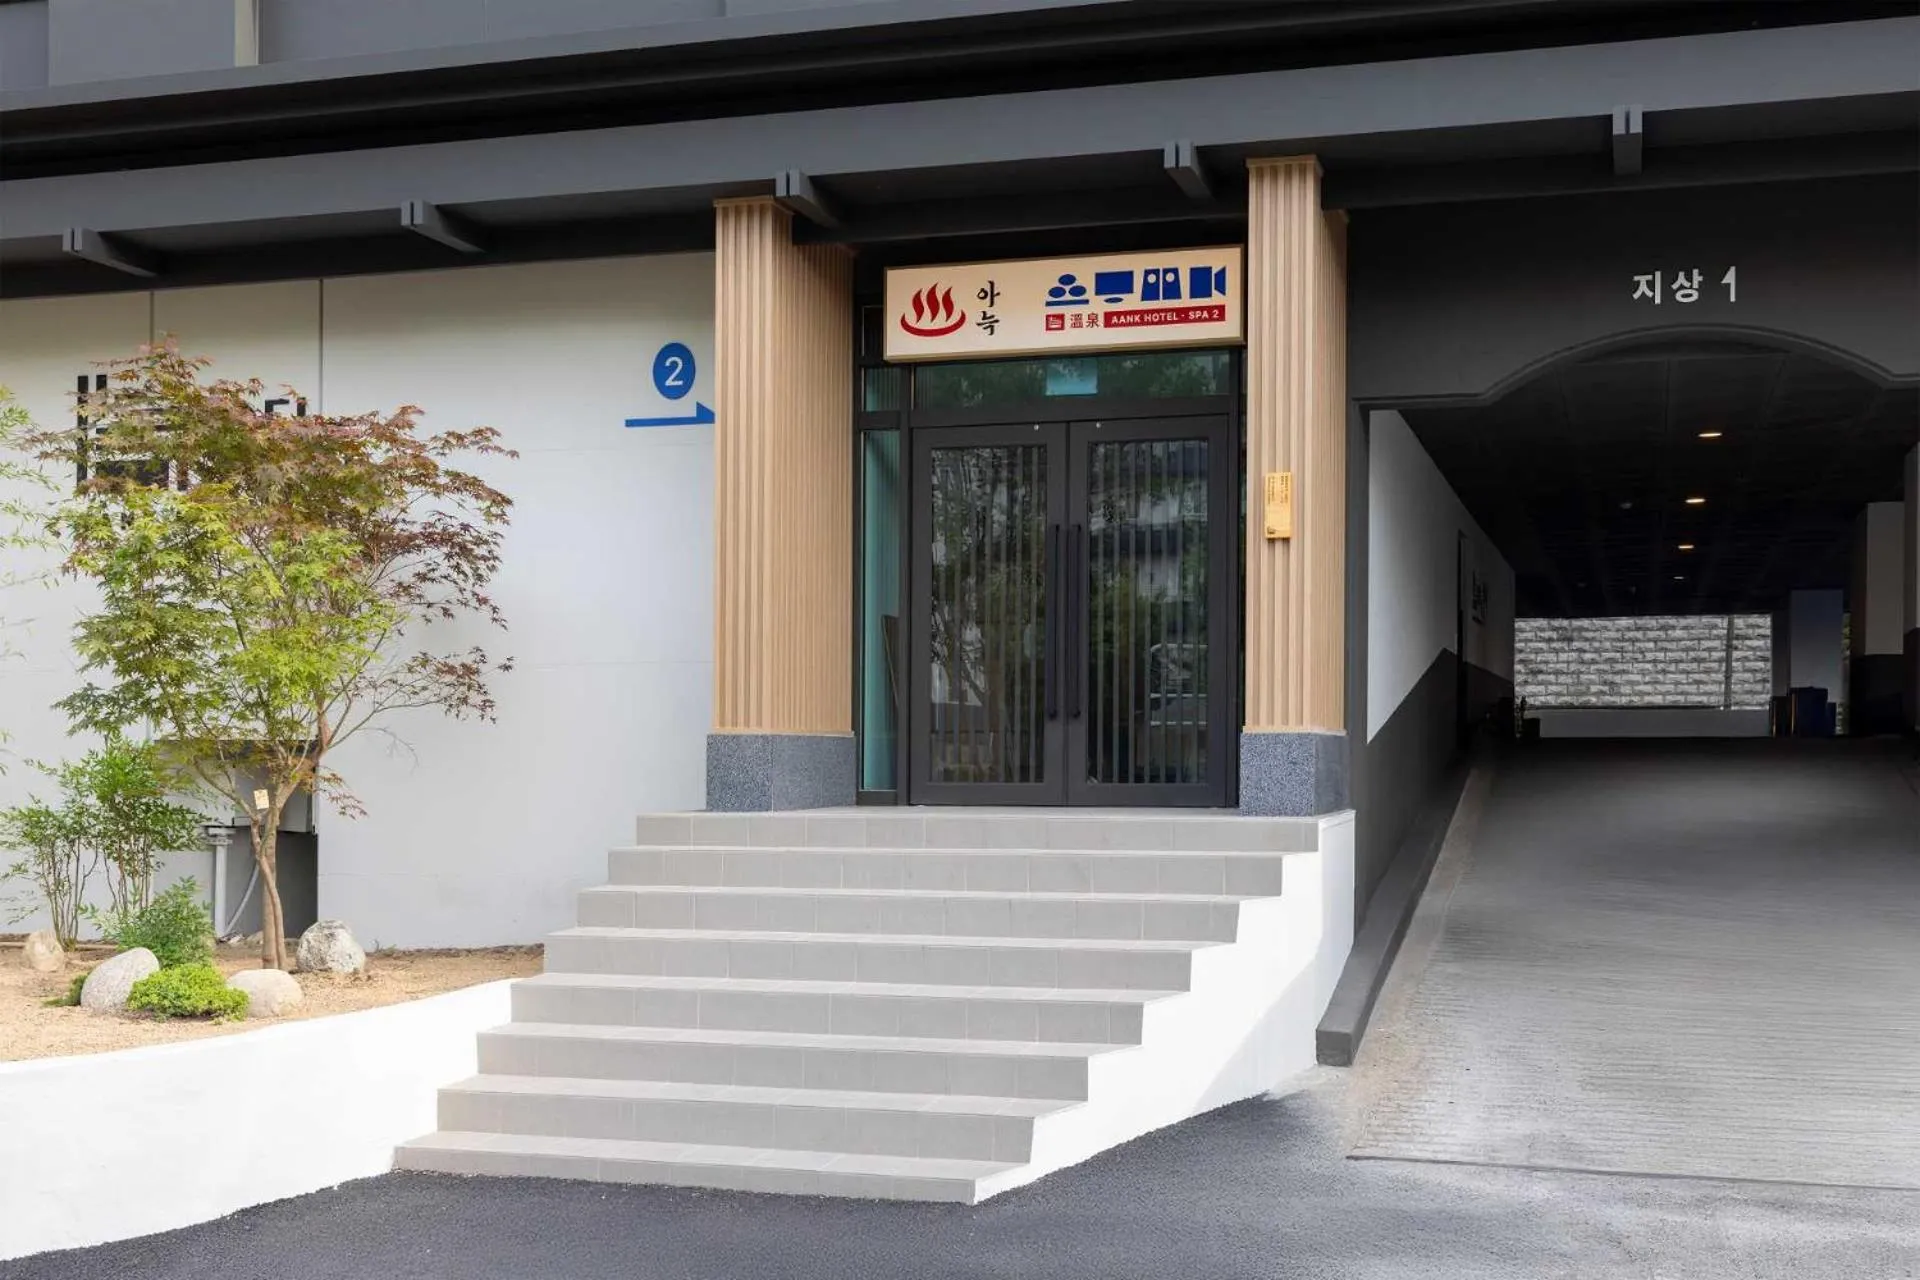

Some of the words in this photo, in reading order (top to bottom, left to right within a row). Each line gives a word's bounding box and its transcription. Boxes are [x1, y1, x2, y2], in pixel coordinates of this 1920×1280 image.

[1632, 268, 1704, 305] 지상
[1720, 265, 1737, 302] 1
[975, 280, 1001, 336] 아늑
[1111, 314, 1140, 325] AANK
[1144, 311, 1178, 322] HOTEL
[1188, 310, 1209, 320] SPA
[1212, 309, 1220, 318] 2
[664, 356, 683, 386] 2
